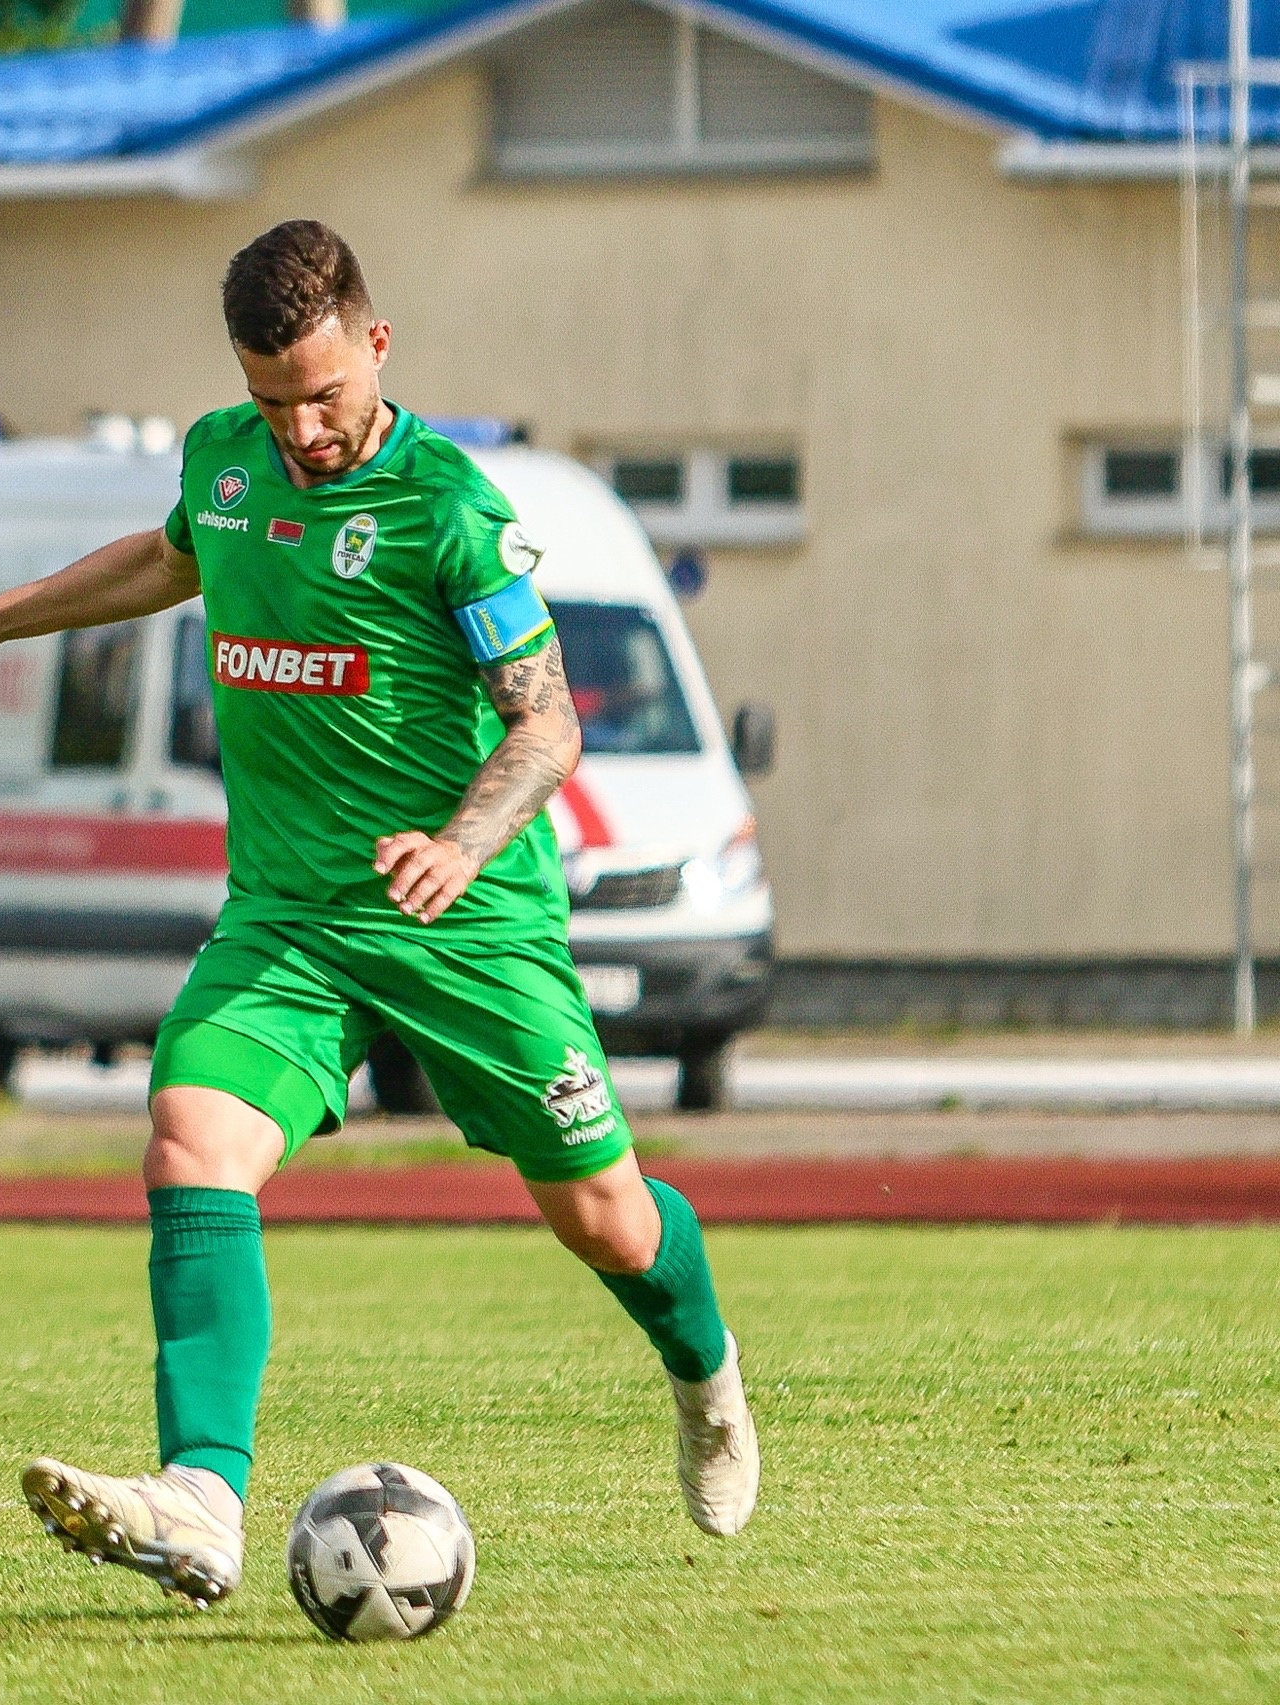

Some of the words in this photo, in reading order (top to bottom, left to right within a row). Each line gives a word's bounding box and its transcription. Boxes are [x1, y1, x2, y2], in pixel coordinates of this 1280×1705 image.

[197, 510, 249, 532] uhlsport
[477, 607, 505, 652] uhlsport
[216, 641, 356, 687] FONBET
